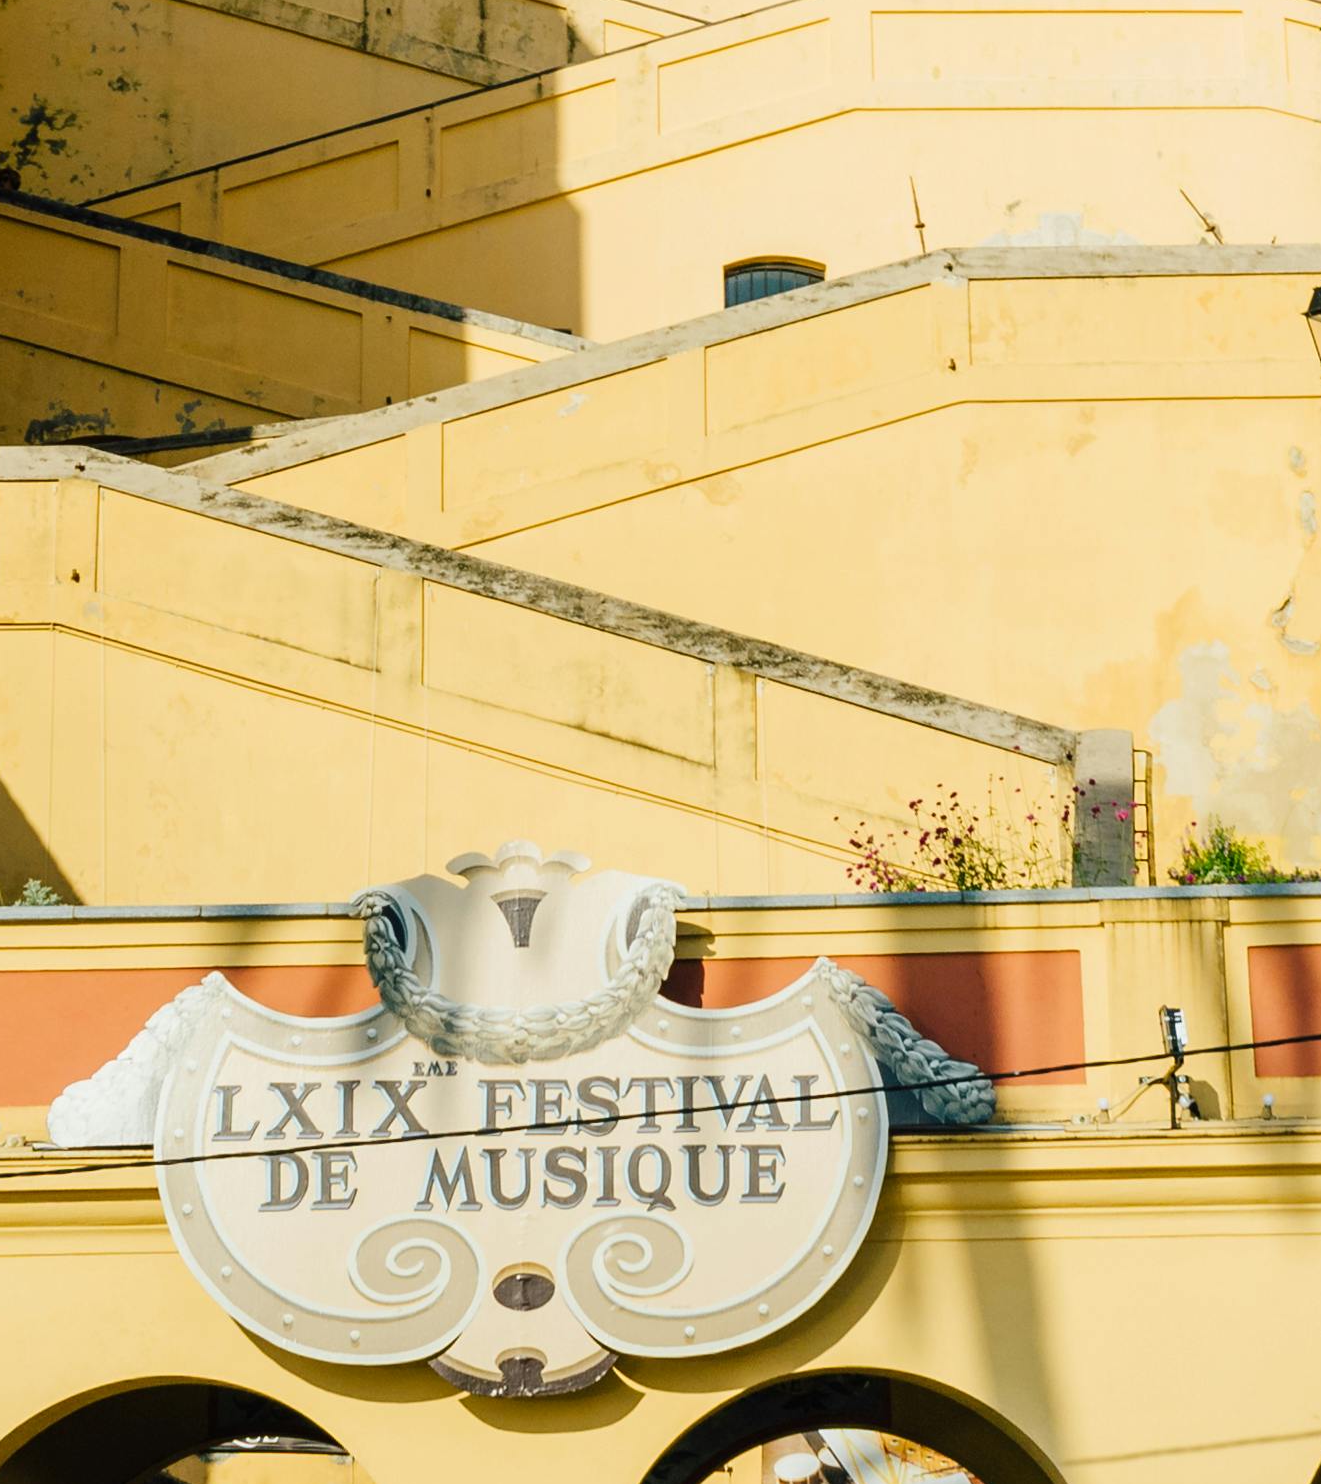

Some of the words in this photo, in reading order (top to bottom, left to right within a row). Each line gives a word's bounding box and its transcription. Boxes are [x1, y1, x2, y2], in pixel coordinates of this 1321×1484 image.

[211, 1080, 429, 1141] LXIX
[474, 1073, 840, 1137] FESTIVAL
[258, 1150, 358, 1212] DE
[414, 1144, 786, 1212] MUSIQUE
